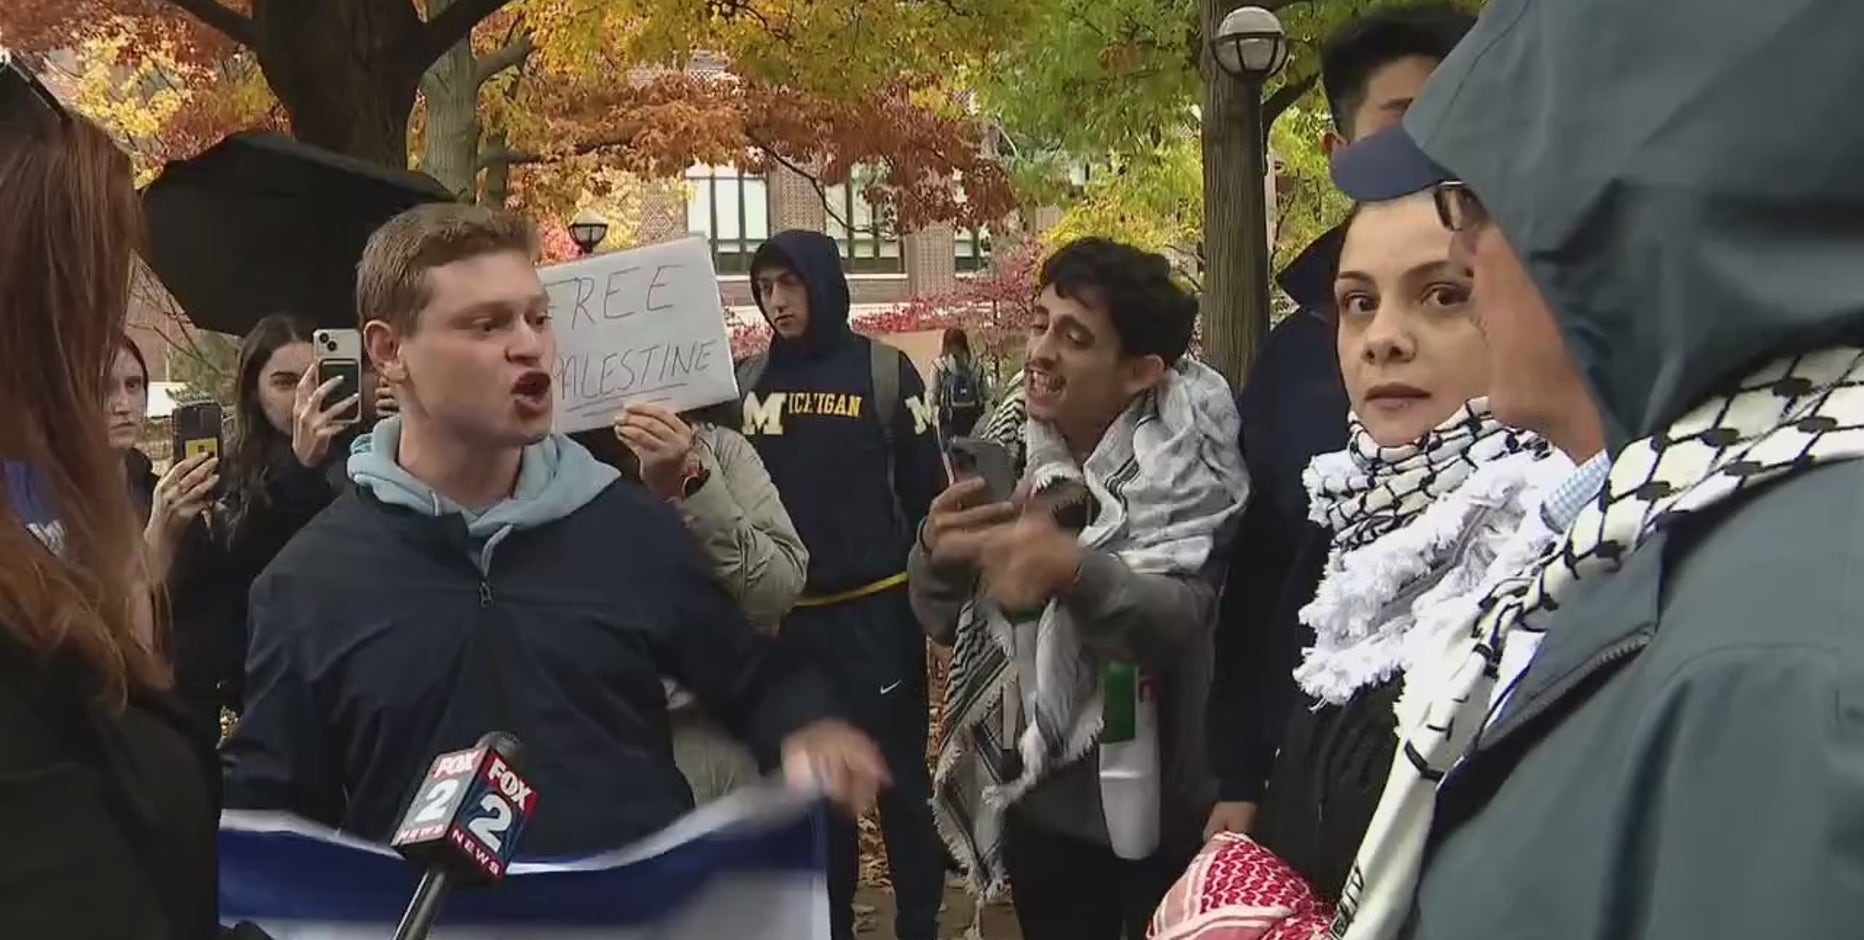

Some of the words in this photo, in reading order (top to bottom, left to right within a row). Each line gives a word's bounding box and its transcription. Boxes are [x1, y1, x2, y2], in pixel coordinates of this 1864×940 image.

[556, 338, 718, 400] ALESTINE
[741, 391, 862, 435] MICHIGAN
[433, 750, 481, 779] FOX
[488, 758, 532, 812] FOX
[415, 779, 459, 822] 2
[397, 824, 445, 841] NEWS
[468, 794, 512, 853] 2
[452, 829, 500, 876] NEWS
